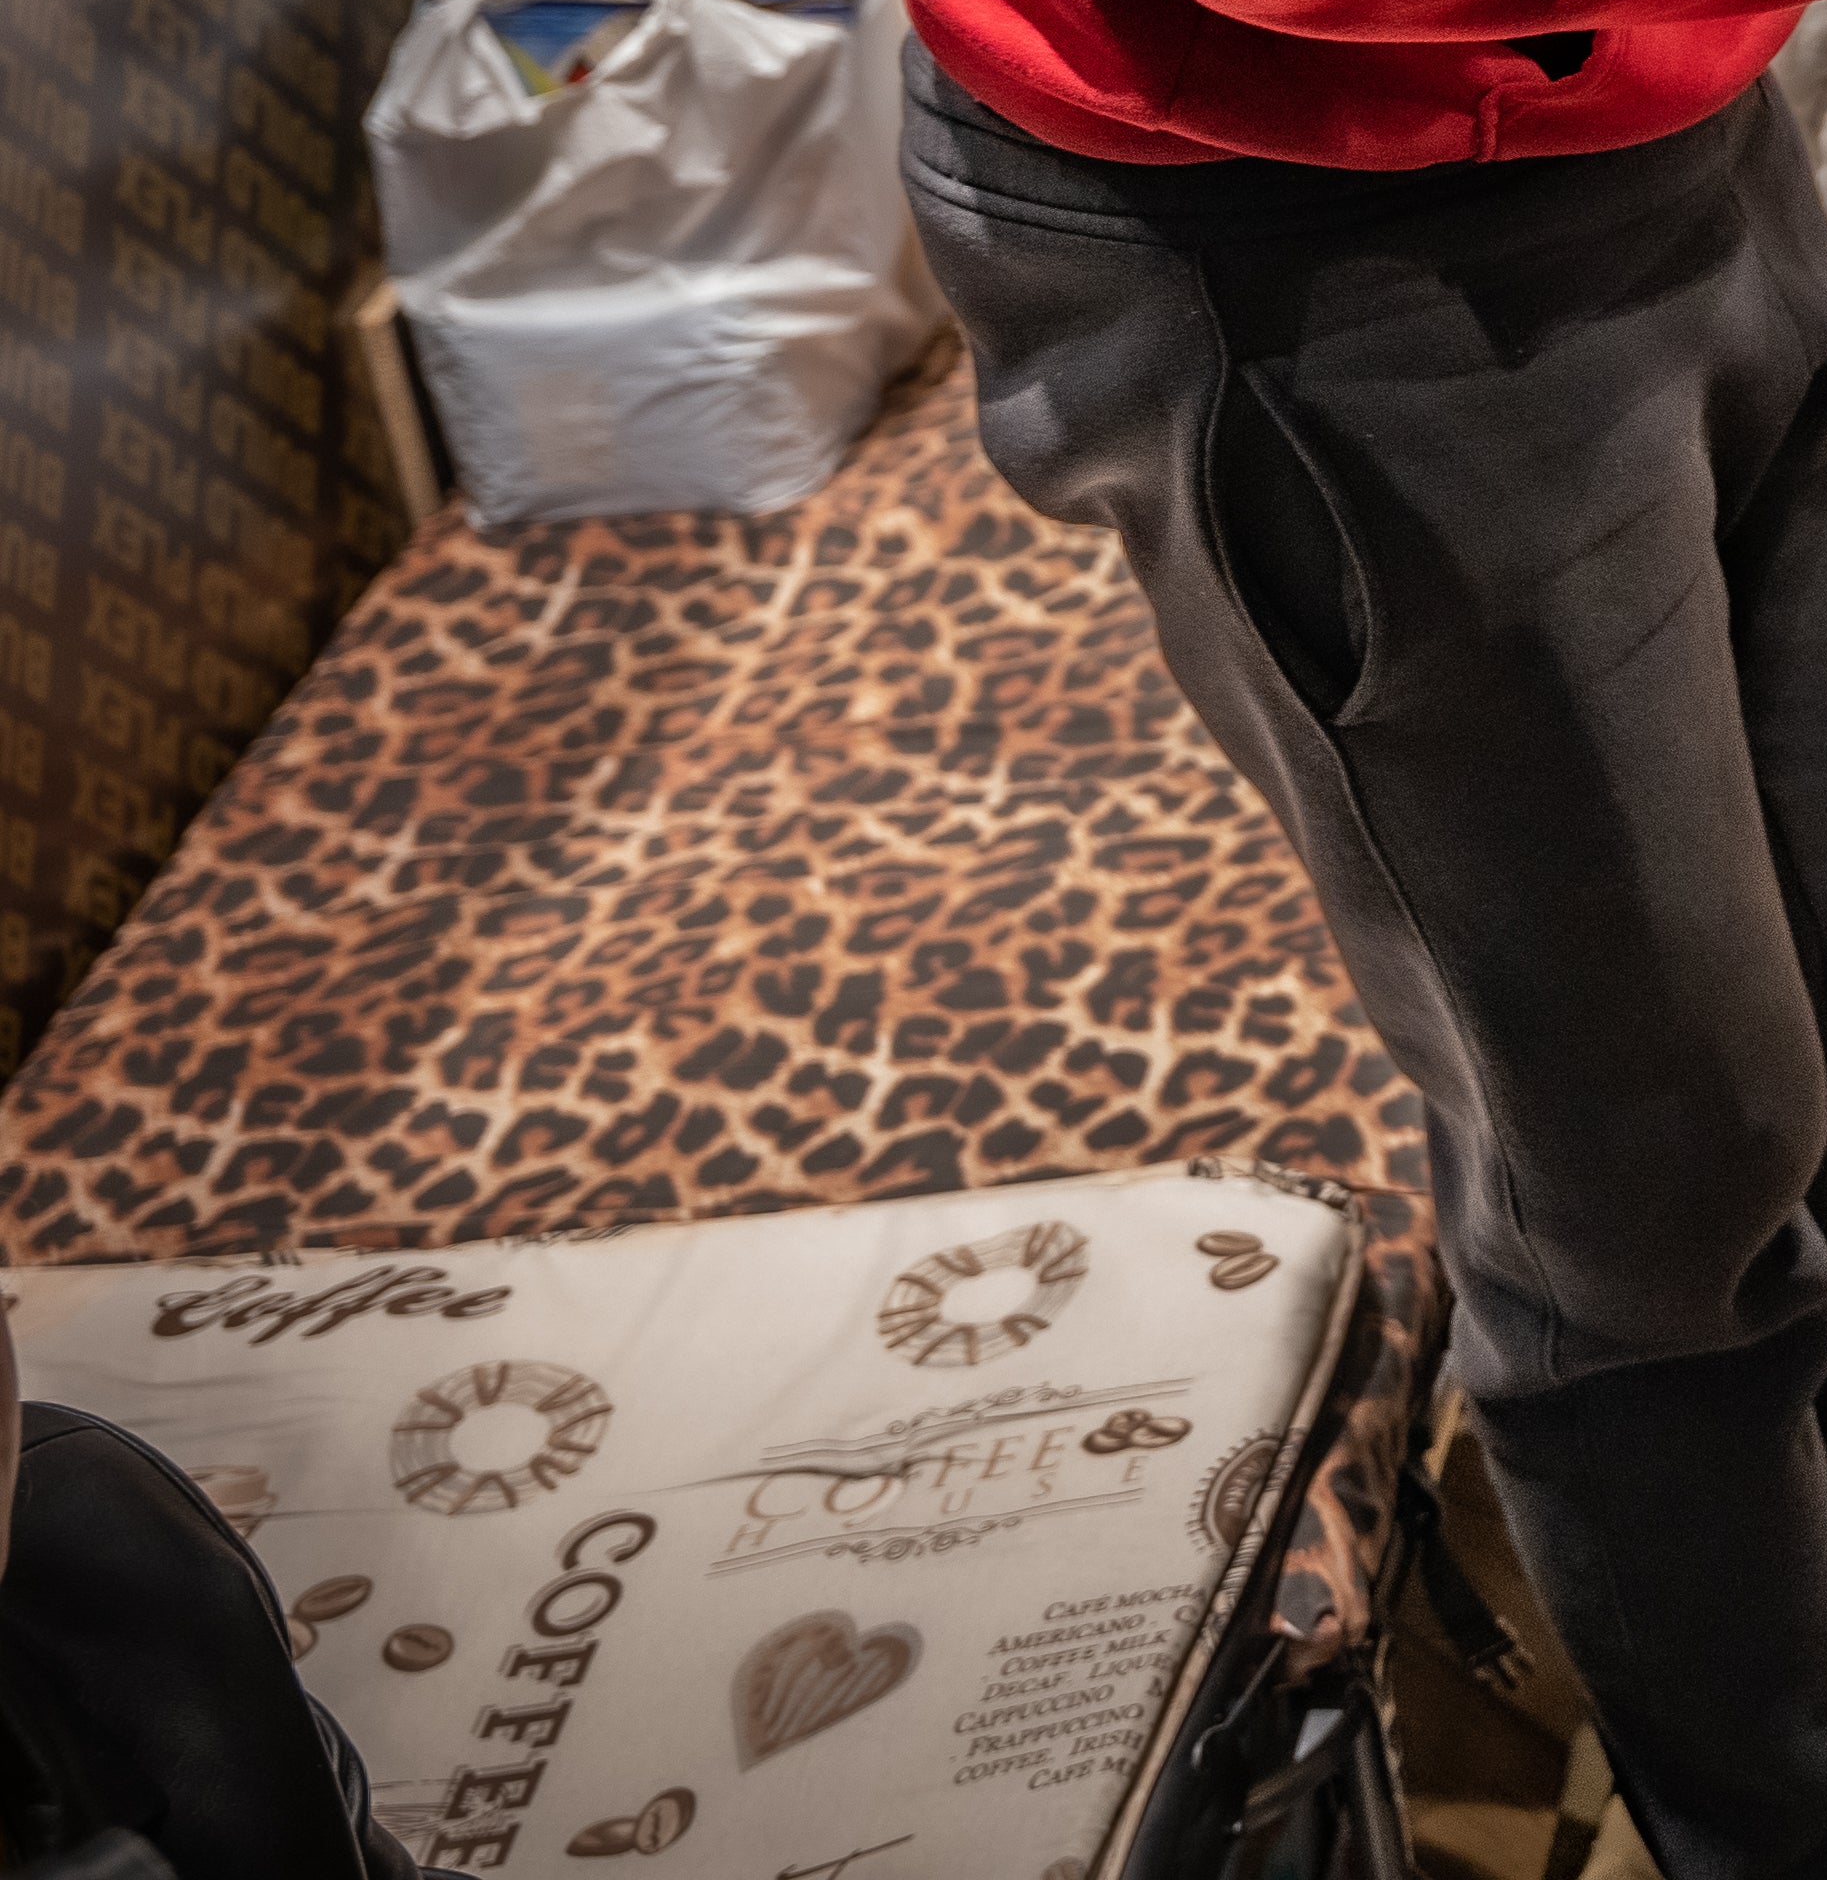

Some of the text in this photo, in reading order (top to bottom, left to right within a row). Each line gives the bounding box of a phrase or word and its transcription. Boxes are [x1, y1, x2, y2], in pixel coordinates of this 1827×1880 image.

[98, 399, 197, 519] PLEX
[93, 484, 192, 605] PLEX
[84, 571, 186, 692] PLEX
[78, 663, 180, 782] PLEX
[151, 1265, 513, 1347] Coffee
[420, 1507, 659, 1870] COFFEE
[988, 1613, 1147, 1656] AMERICANO
[1001, 1628, 1172, 1677] COFFEE MILK
[953, 1683, 1115, 1735] CAPPUCCINO
